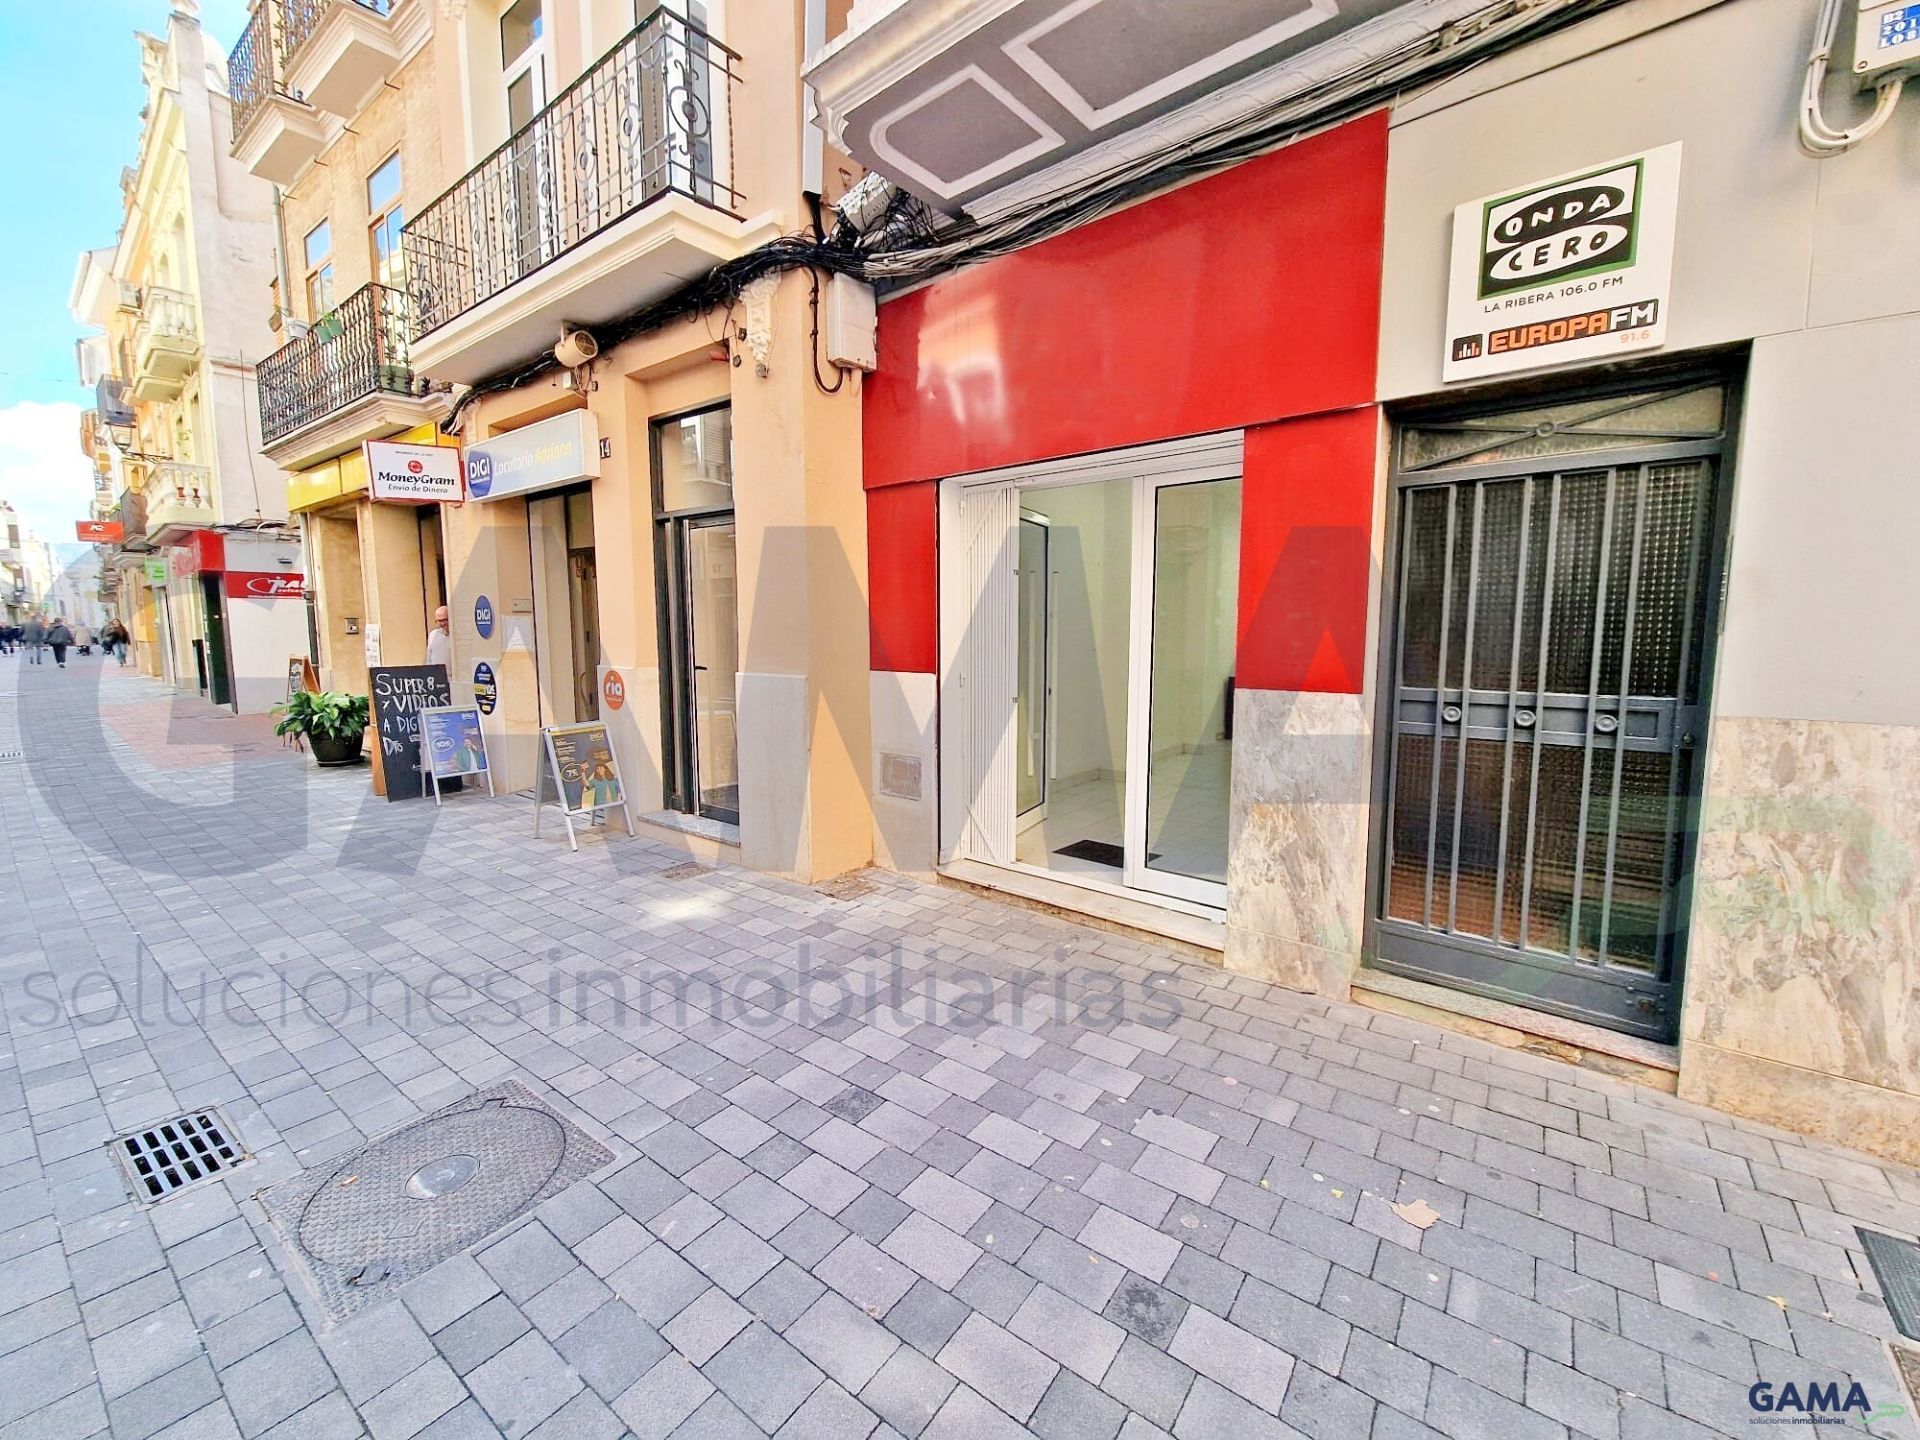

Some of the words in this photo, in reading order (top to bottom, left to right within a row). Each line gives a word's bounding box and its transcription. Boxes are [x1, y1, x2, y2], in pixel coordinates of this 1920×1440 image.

[1505, 193, 1611, 237] ONDA
[1508, 230, 1608, 272] CERO
[1484, 303, 1501, 313] LA
[1505, 291, 1555, 309] RIBERA
[1560, 281, 1598, 297] 106.0
[1602, 276, 1624, 289] FM
[1619, 331, 1650, 344] 91.6
[494, 450, 534, 477] Locutorio
[535, 441, 572, 465] Adriana
[600, 440, 611, 458] 14
[377, 471, 455, 486] MoneyGram
[469, 457, 491, 479] DIGI
[411, 484, 420, 493] de
[422, 486, 448, 494] Dinero
[476, 608, 491, 620] DIGI
[375, 673, 427, 696] SUPER
[605, 674, 623, 697] ria
[392, 692, 450, 713] VIDEOS
[383, 718, 391, 733] A
[396, 715, 419, 735] DIG
